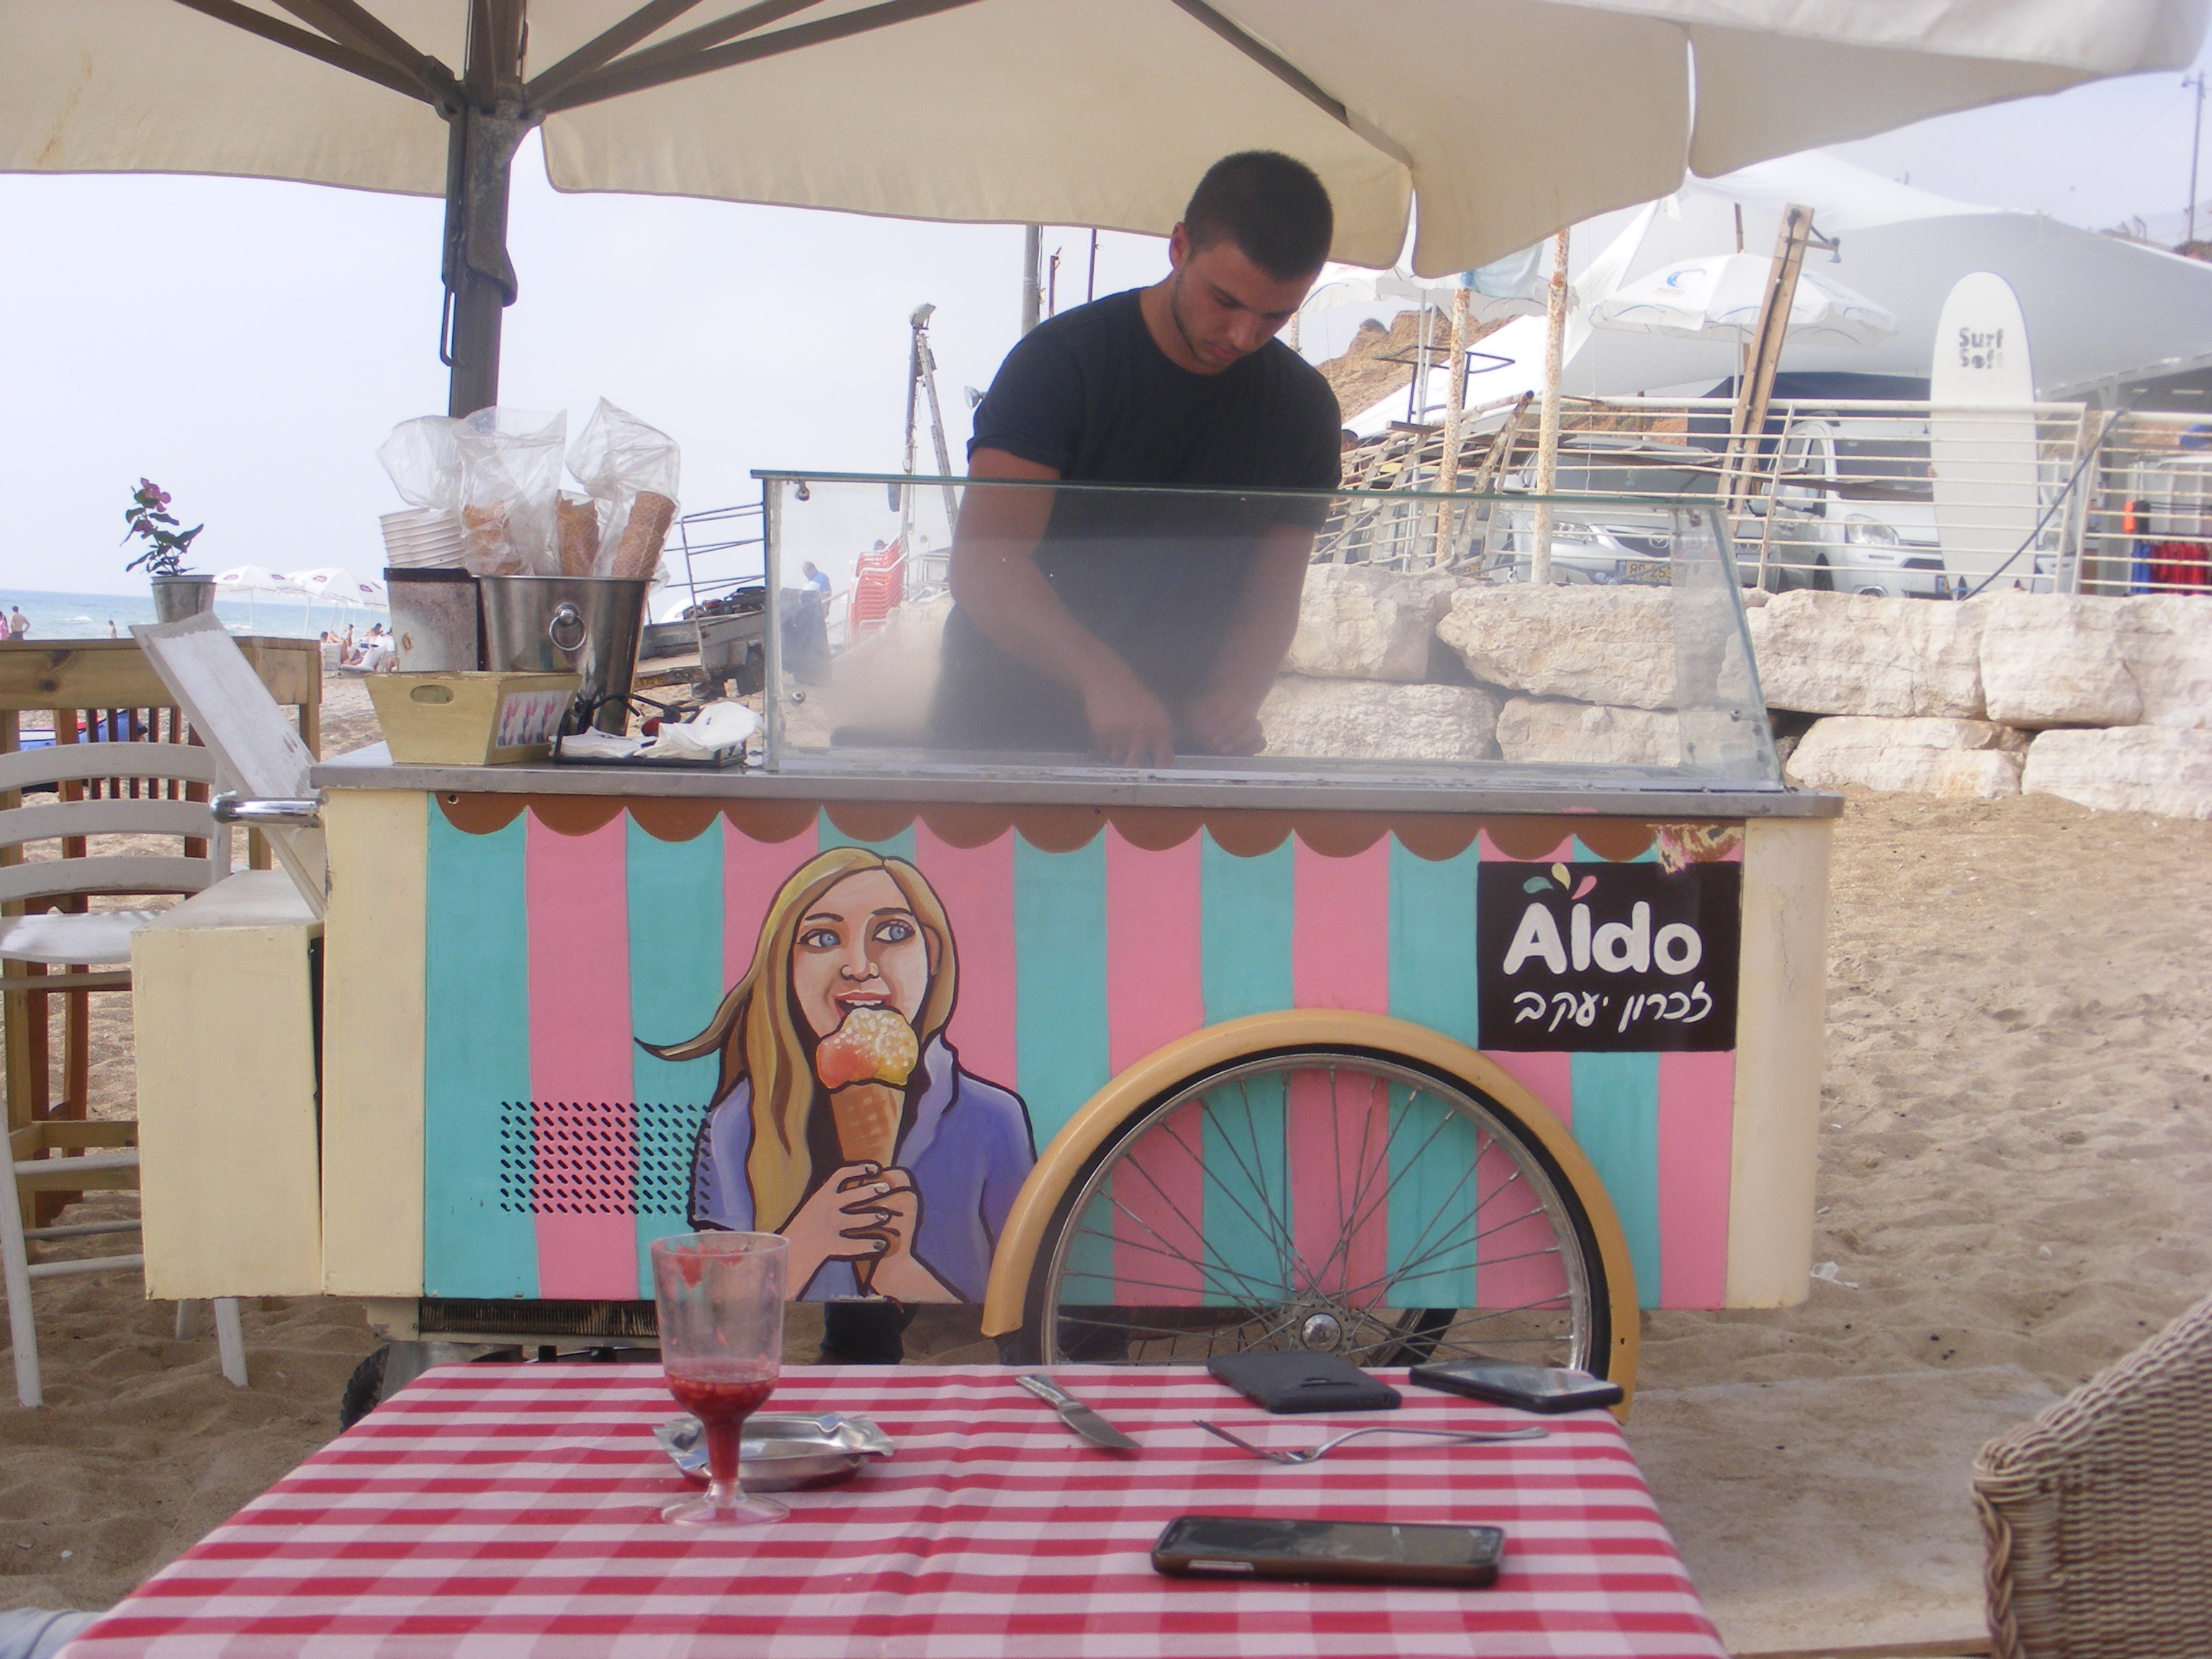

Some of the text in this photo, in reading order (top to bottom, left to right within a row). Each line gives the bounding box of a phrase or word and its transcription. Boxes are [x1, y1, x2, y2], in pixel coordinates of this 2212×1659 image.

[1959, 326, 2004, 349] Surf
[1503, 901, 1703, 976] Aldo
[1513, 980, 1714, 1033] זכרון יעקב
